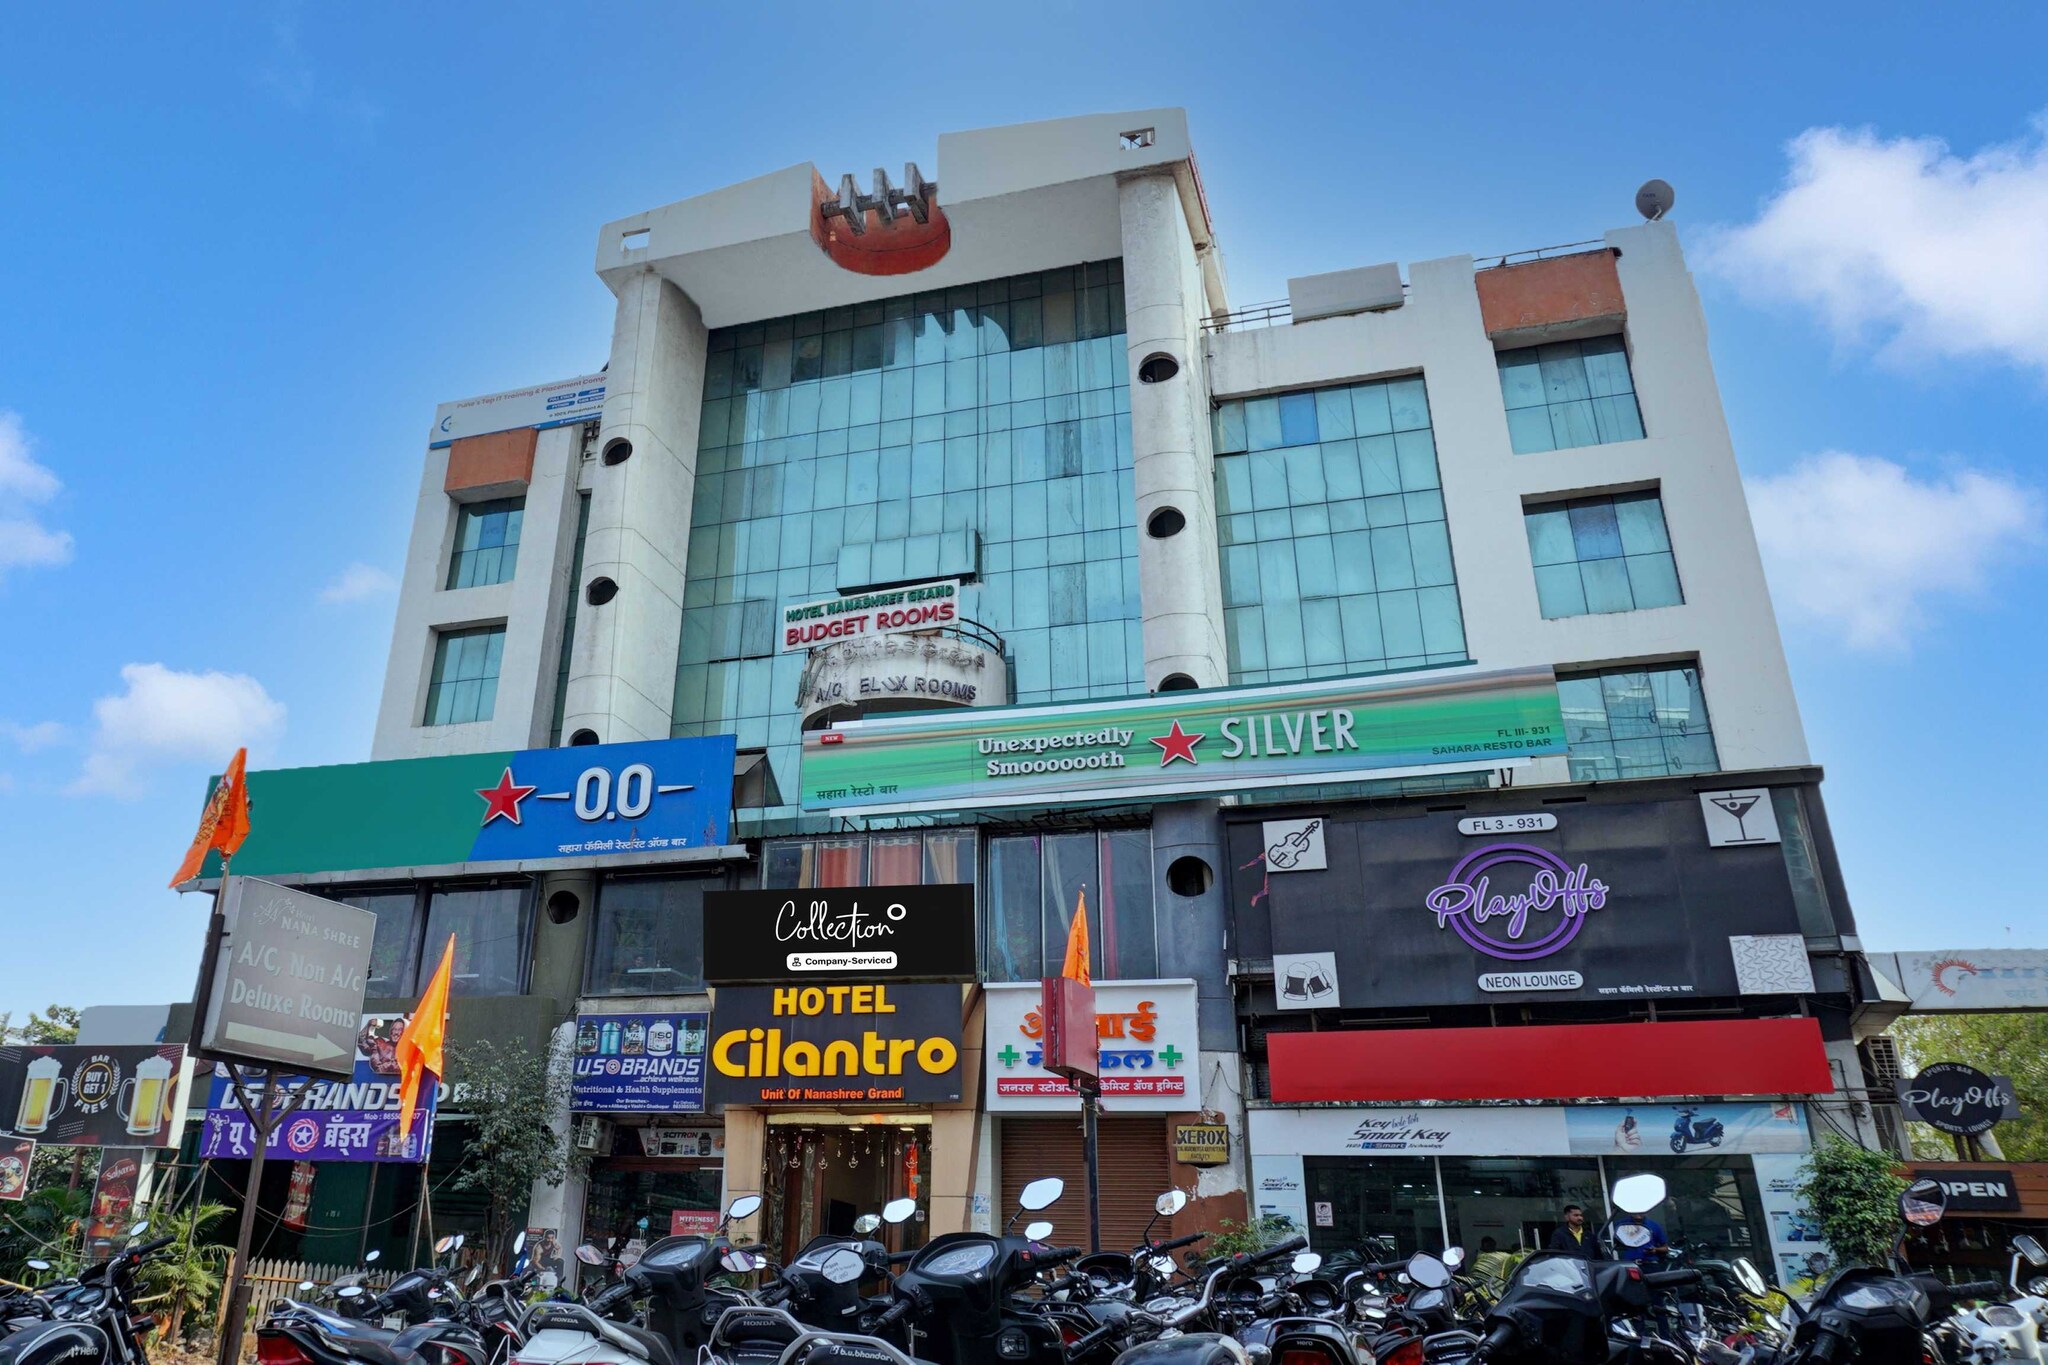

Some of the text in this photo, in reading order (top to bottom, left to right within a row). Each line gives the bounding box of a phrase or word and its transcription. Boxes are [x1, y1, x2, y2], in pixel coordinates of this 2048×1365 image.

[504, 390, 534, 400] Training
[541, 381, 581, 394] Placement
[786, 605, 825, 622] HOTEL
[908, 584, 955, 601] GRAND
[786, 602, 955, 646] BUDGET ROOMS
[914, 676, 977, 701] ROOMS
[977, 708, 1360, 759] Unexpectedly SILVER
[1498, 729, 1512, 738] FL
[1531, 725, 1551, 735] 931
[1432, 738, 1552, 755] SAHARA RESTO BAR
[816, 789, 847, 800] सहारा
[850, 783, 875, 797] रेस्टो
[1473, 821, 1491, 831] FL
[1496, 820, 1504, 830] 3
[1517, 817, 1543, 829] 931
[558, 844, 582, 854] सहारा
[671, 838, 687, 847] बार
[1426, 863, 1610, 939] PlayOffs
[775, 900, 895, 948] Collection
[281, 916, 361, 949] NANA SHREE
[238, 940, 284, 977] A/C,
[289, 951, 325, 983] Non
[805, 956, 893, 967] Company-Serviced
[1485, 973, 1577, 989] NEON LOUNGE
[231, 977, 356, 1029] Deluxe Rooms
[772, 984, 896, 1016] HOTEL
[91, 1054, 110, 1063] BAR
[711, 1027, 959, 1078] Cilantro
[577, 1058, 702, 1076] US BRANDS
[1923, 1065, 1950, 1077] SPORTS
[85, 1071, 109, 1082] BUY 1
[83, 1083, 106, 1094] GET 1
[572, 1085, 703, 1095] Nutritional & Health Supplements
[761, 1087, 902, 1100] Unit Of Nanashree Grand
[999, 1083, 1034, 1093] जनरल
[74, 1099, 109, 1114] FREE
[1901, 1086, 2012, 1116] PlayOffs
[1359, 1119, 1391, 1130] Key
[663, 1131, 698, 1139] SCITRON
[1178, 1130, 1225, 1145] XEROX
[1348, 1129, 1451, 1142] Smart Key
[106, 1163, 136, 1181] Sahara
[679, 1215, 714, 1223] MYFITNESS
[80, 1346, 99, 1356] Hero
